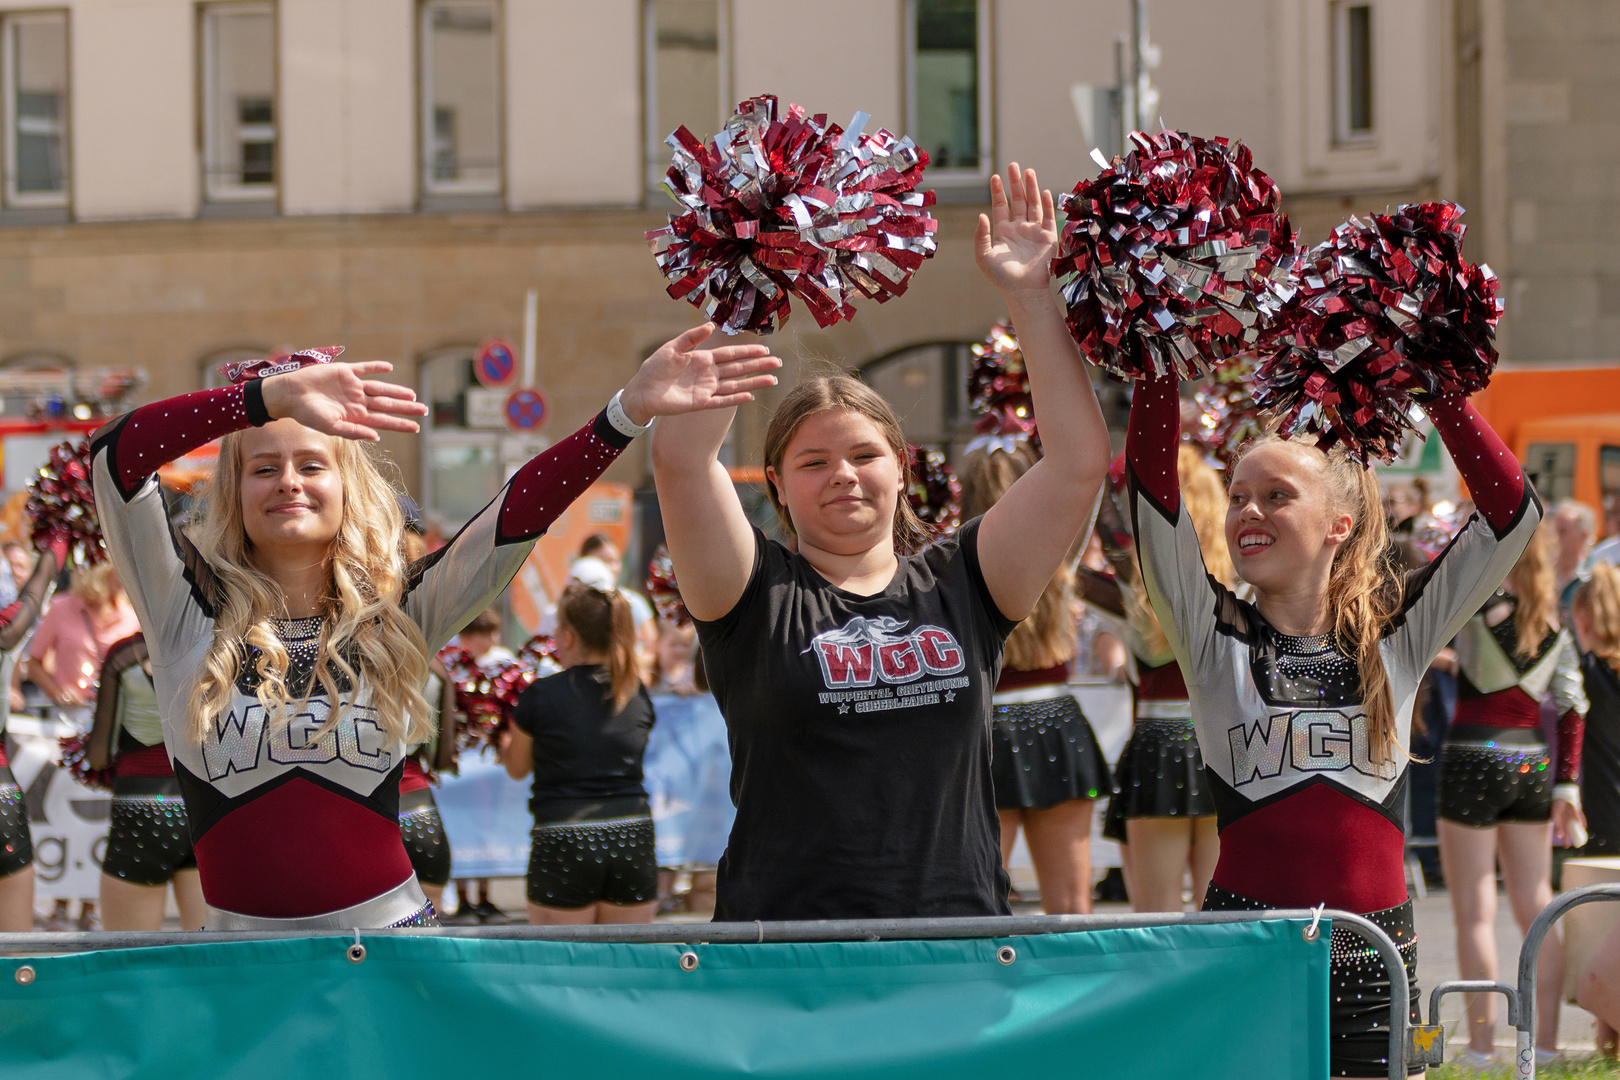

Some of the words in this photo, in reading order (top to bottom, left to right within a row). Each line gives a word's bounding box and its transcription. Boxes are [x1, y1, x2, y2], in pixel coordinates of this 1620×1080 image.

[258, 362, 300, 377] COACH
[813, 625, 965, 689] WGC
[818, 688, 894, 704] WUPPERTAL
[896, 676, 970, 696] GREYHOUNDS
[855, 693, 940, 713] CHEERLEADER
[201, 700, 391, 782] WGC
